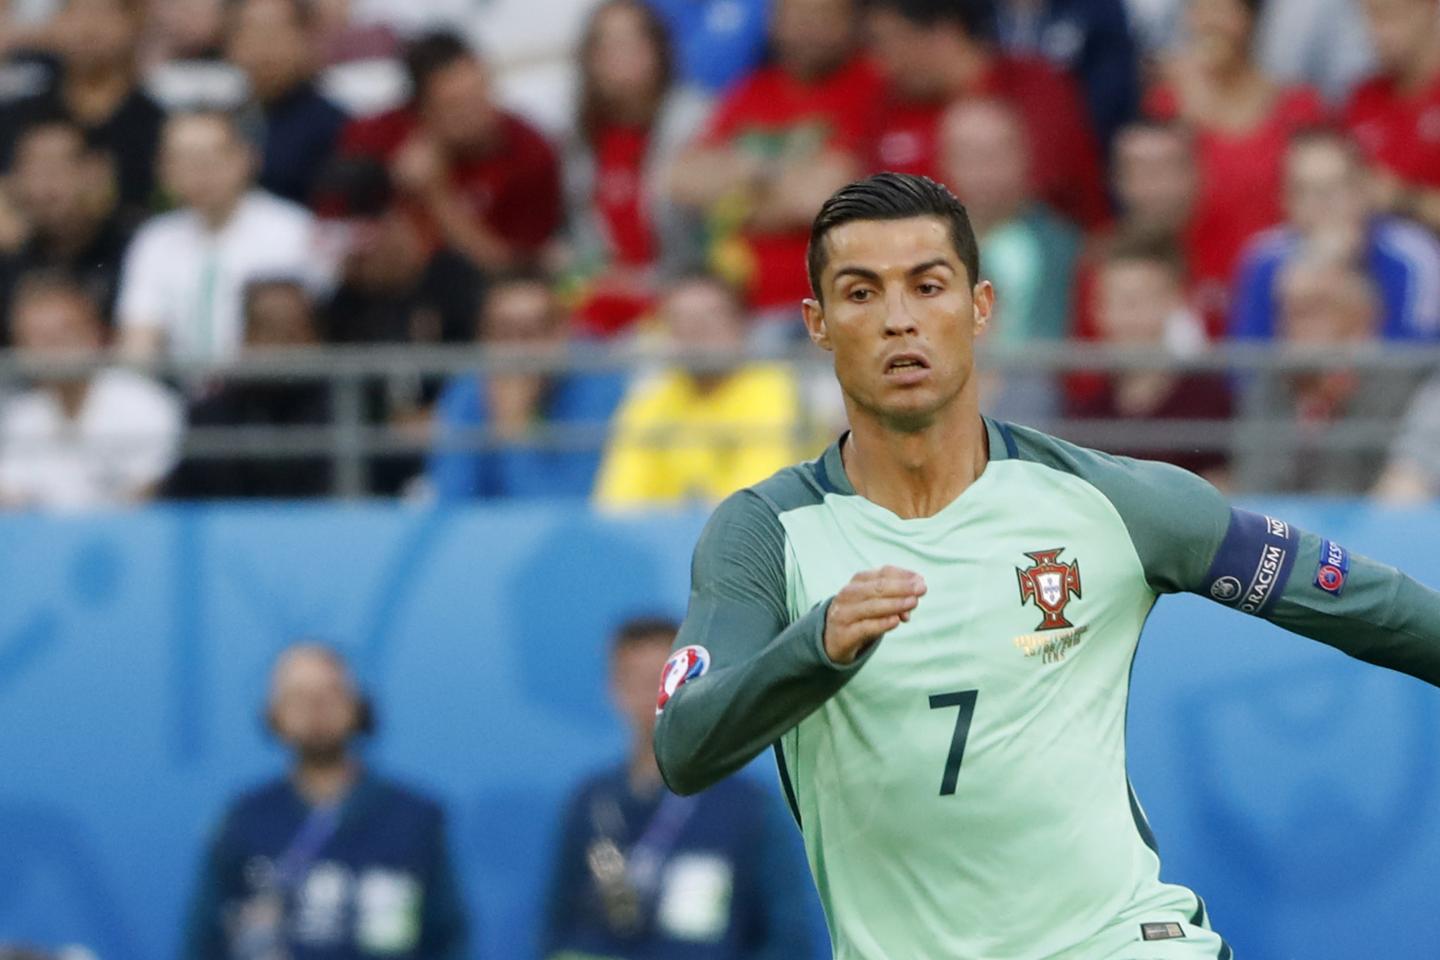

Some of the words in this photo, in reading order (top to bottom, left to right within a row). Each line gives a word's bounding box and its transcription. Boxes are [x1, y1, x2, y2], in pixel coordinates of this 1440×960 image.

[1271, 519, 1285, 538] NO
[1248, 546, 1282, 604] RACISM
[928, 689, 979, 796] 7
